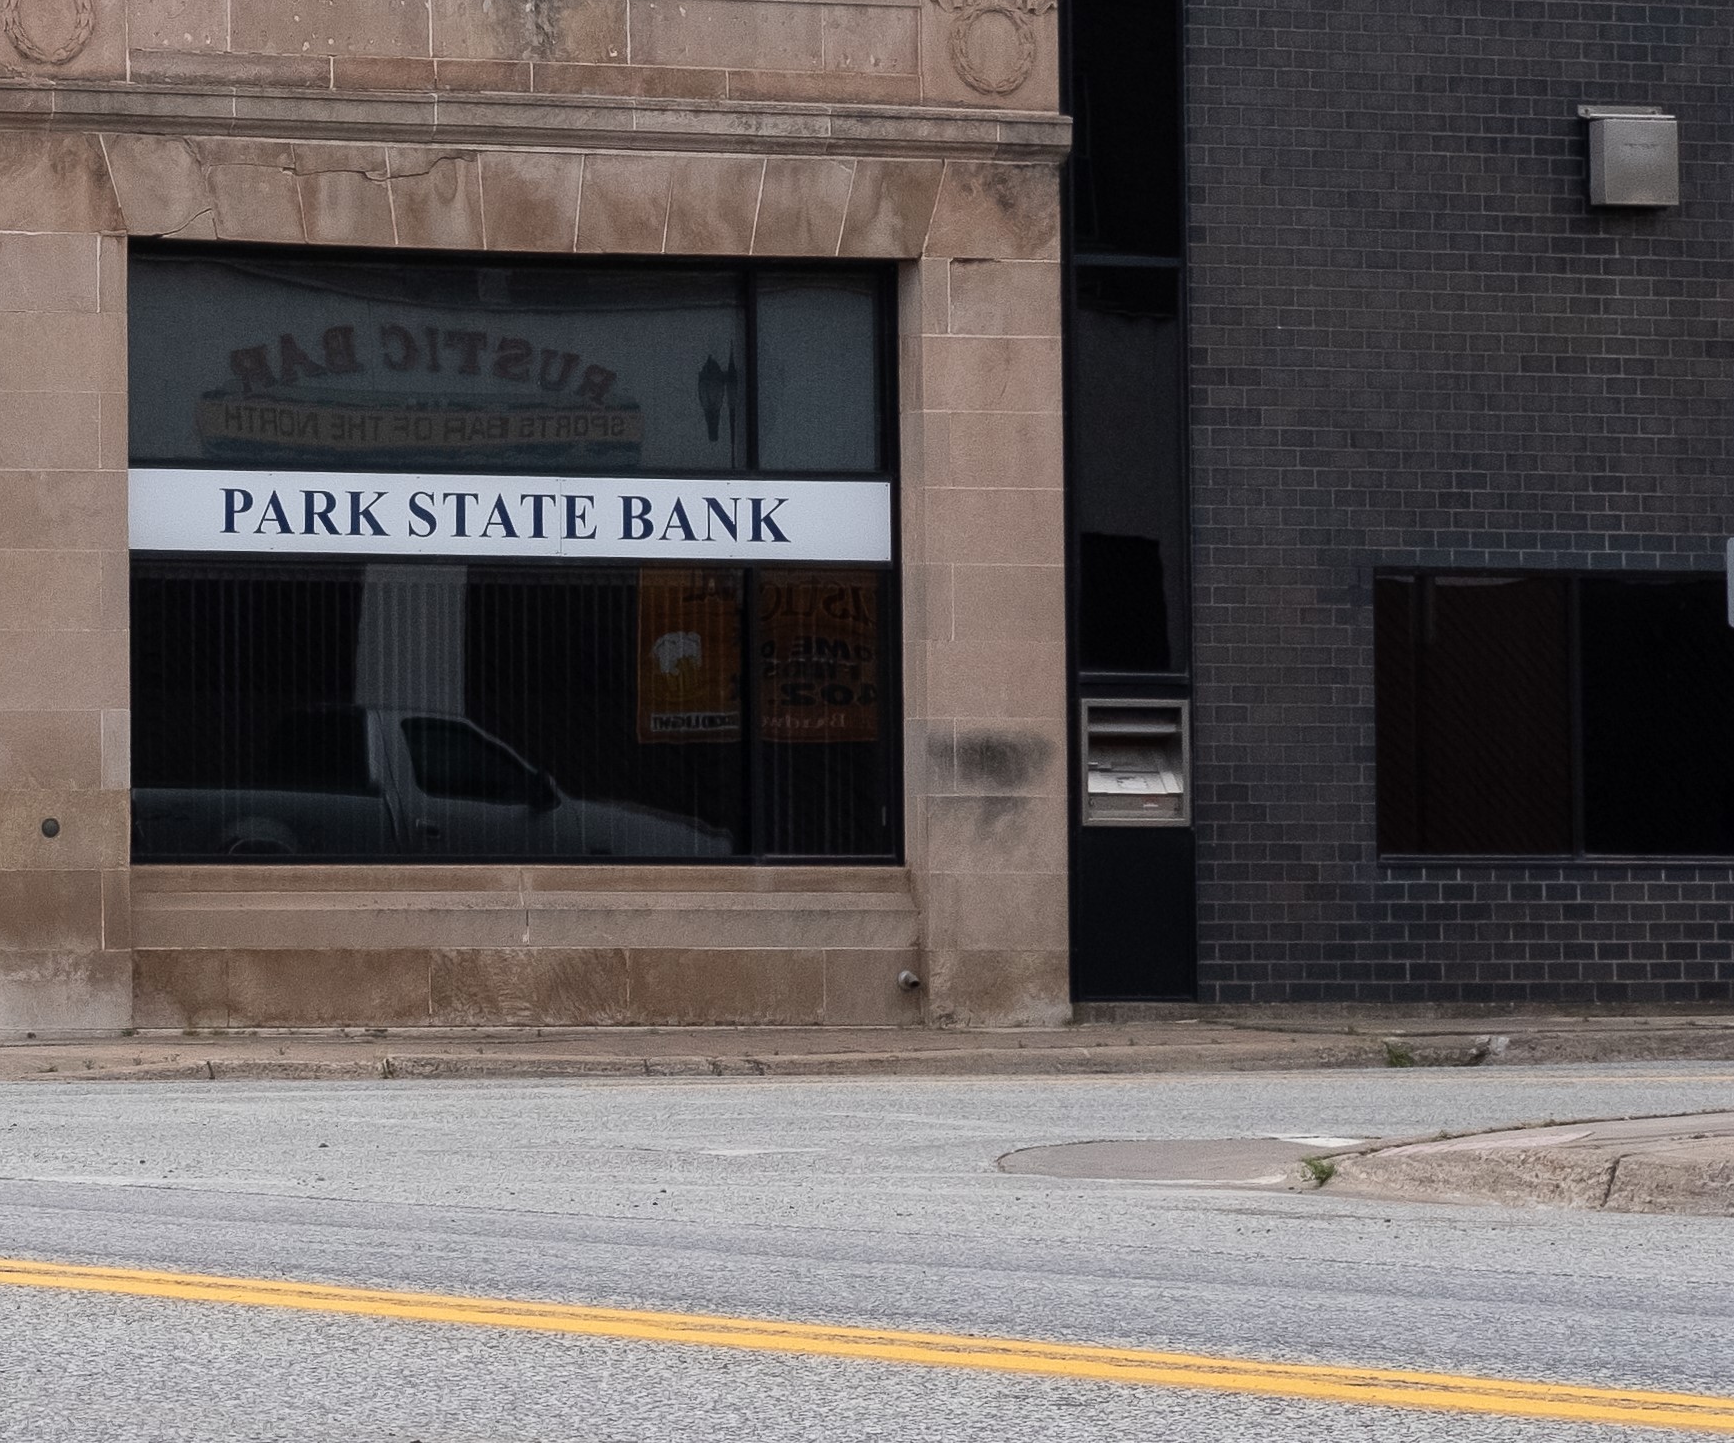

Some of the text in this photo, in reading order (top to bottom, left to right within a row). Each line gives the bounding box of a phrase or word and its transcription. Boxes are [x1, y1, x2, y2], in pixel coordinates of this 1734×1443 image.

[220, 488, 792, 544] PARK STATE BANK
